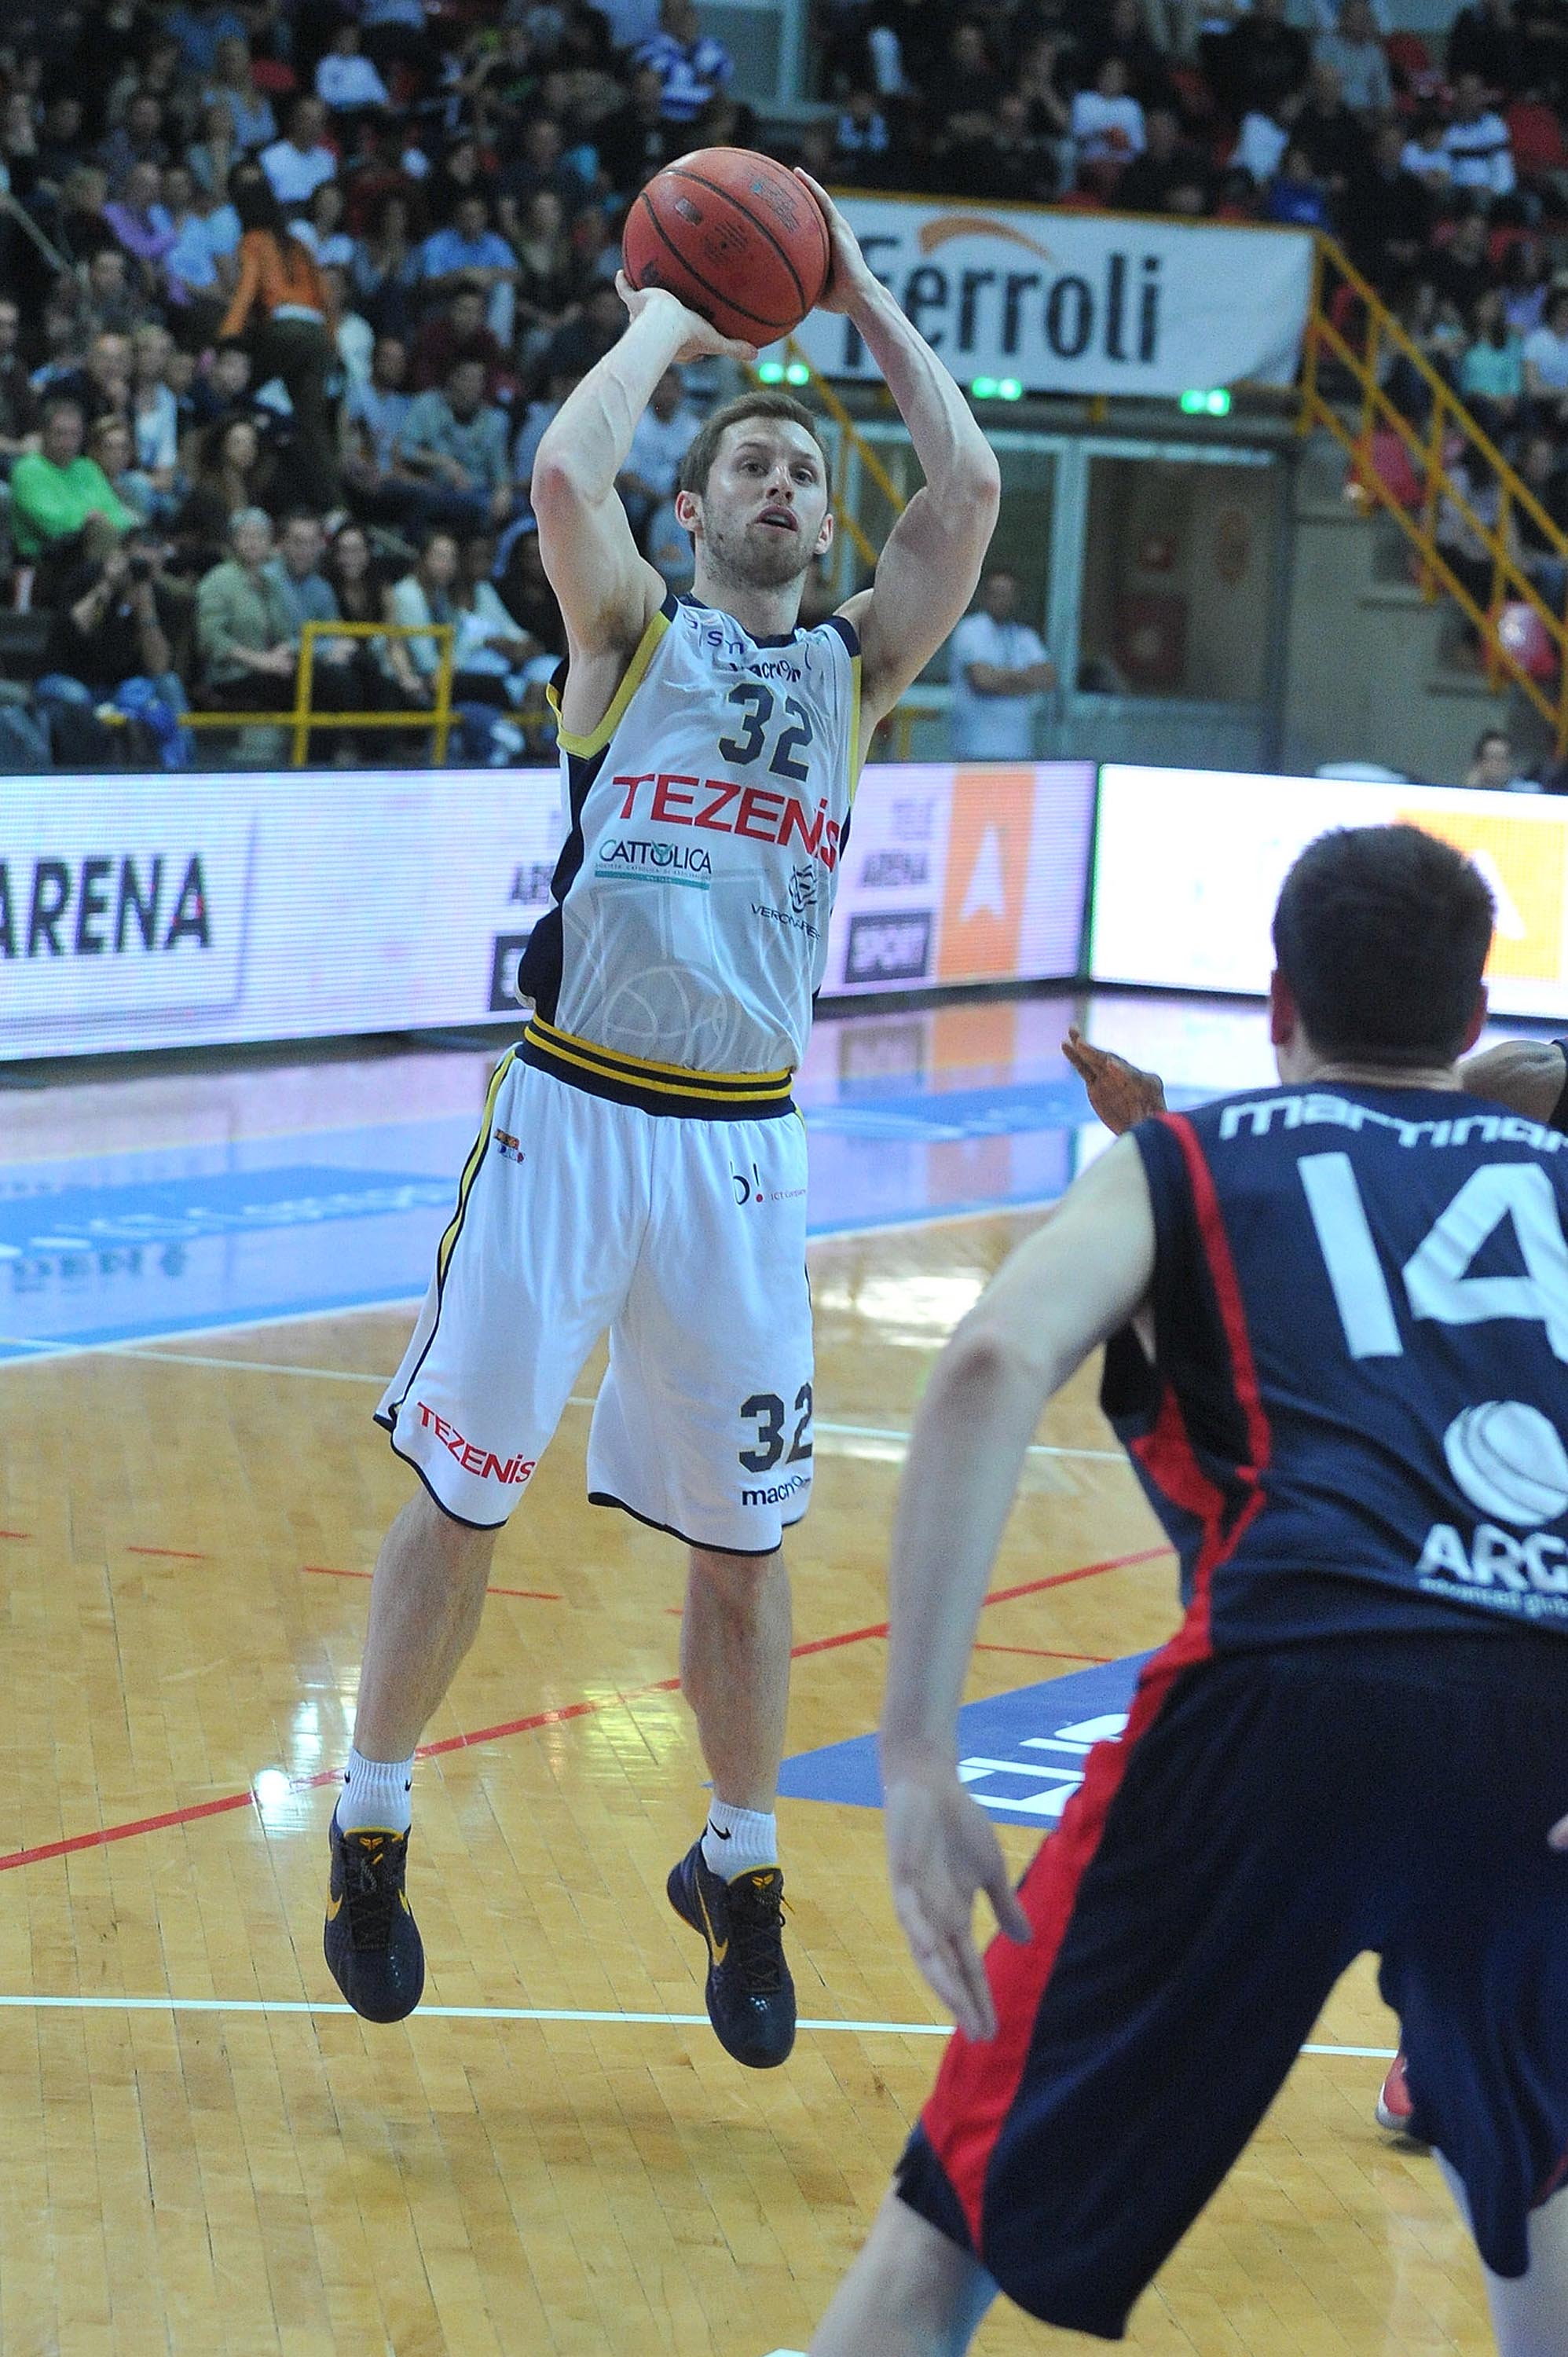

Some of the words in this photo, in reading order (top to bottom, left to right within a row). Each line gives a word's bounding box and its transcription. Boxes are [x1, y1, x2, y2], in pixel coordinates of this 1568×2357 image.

[718, 682, 814, 783] 32
[599, 839, 712, 874] CATTOLICA
[1297, 1151, 1568, 1364] 14
[739, 1383, 812, 1473] 32
